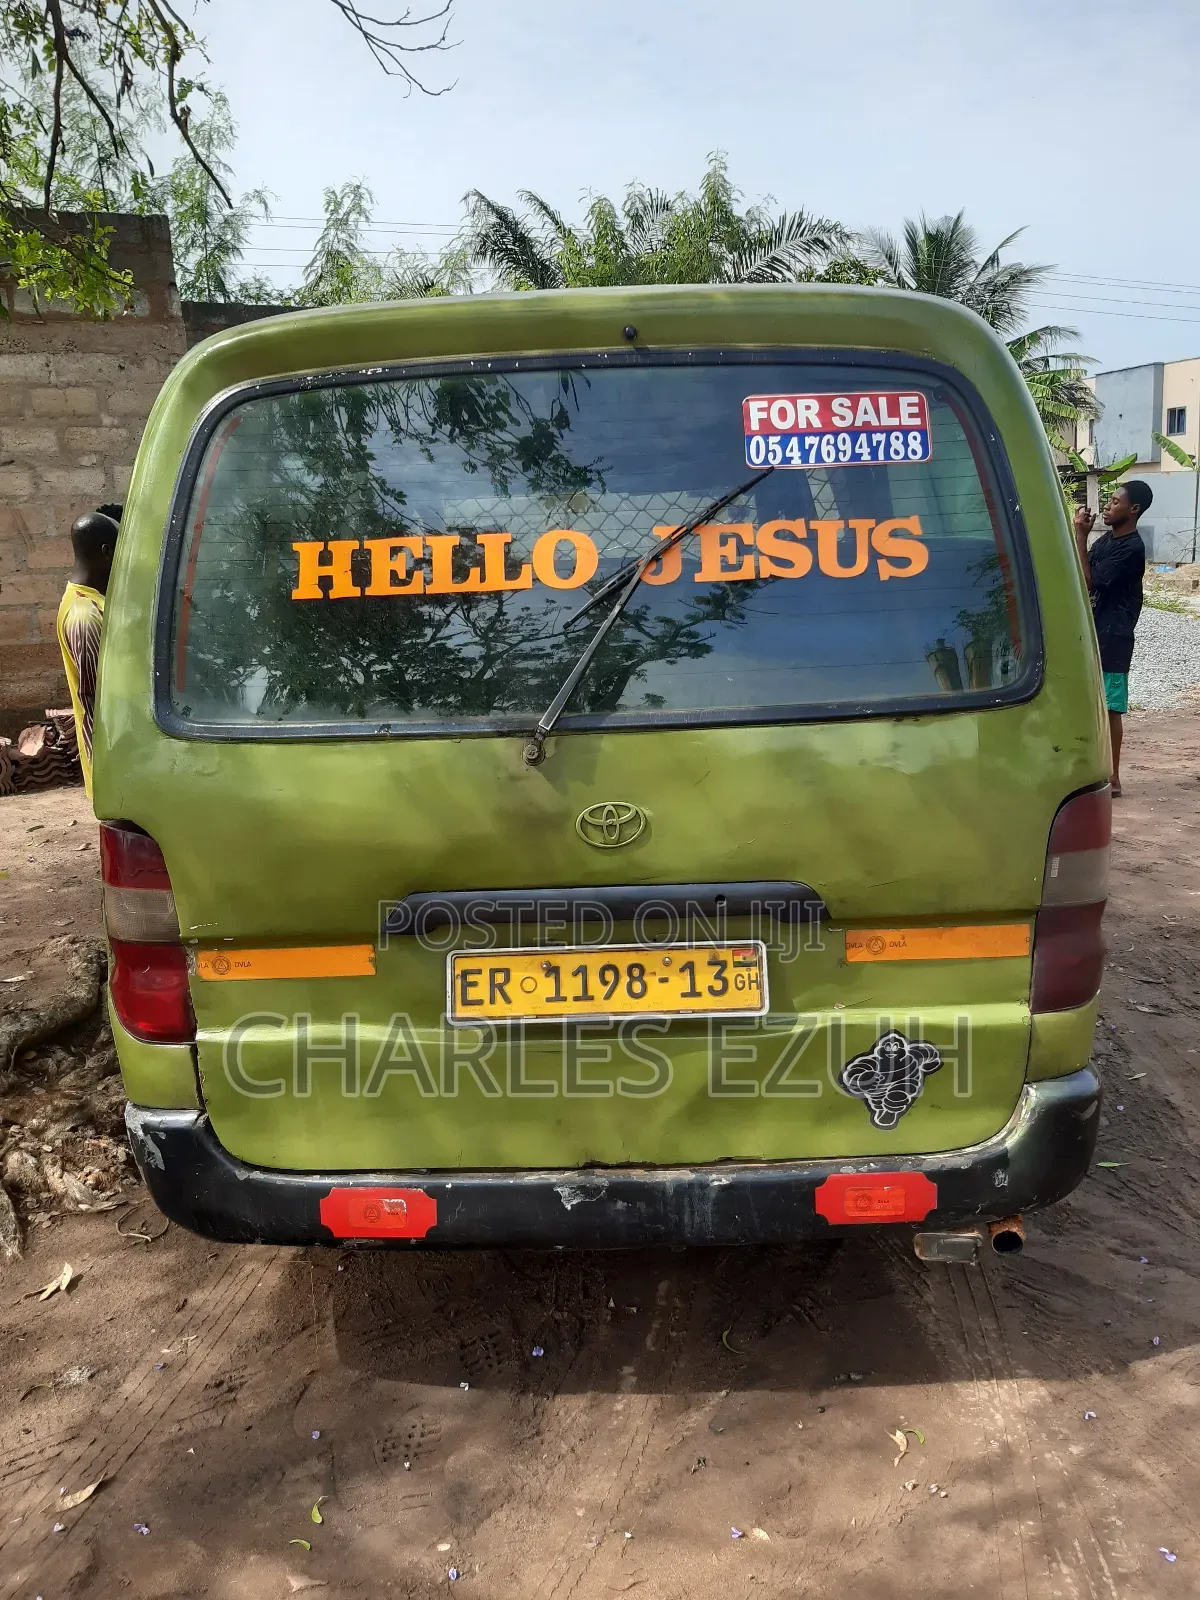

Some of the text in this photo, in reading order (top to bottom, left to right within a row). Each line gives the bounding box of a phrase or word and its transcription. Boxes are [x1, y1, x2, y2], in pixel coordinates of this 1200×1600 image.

[749, 396, 922, 431] FOR SALE
[750, 431, 923, 465] 0547694788
[291, 515, 929, 600] HELLO JESUS
[889, 940, 907, 948] DVLA
[234, 960, 251, 968] DVLA
[460, 967, 512, 1006] ER
[733, 973, 762, 992] GH
